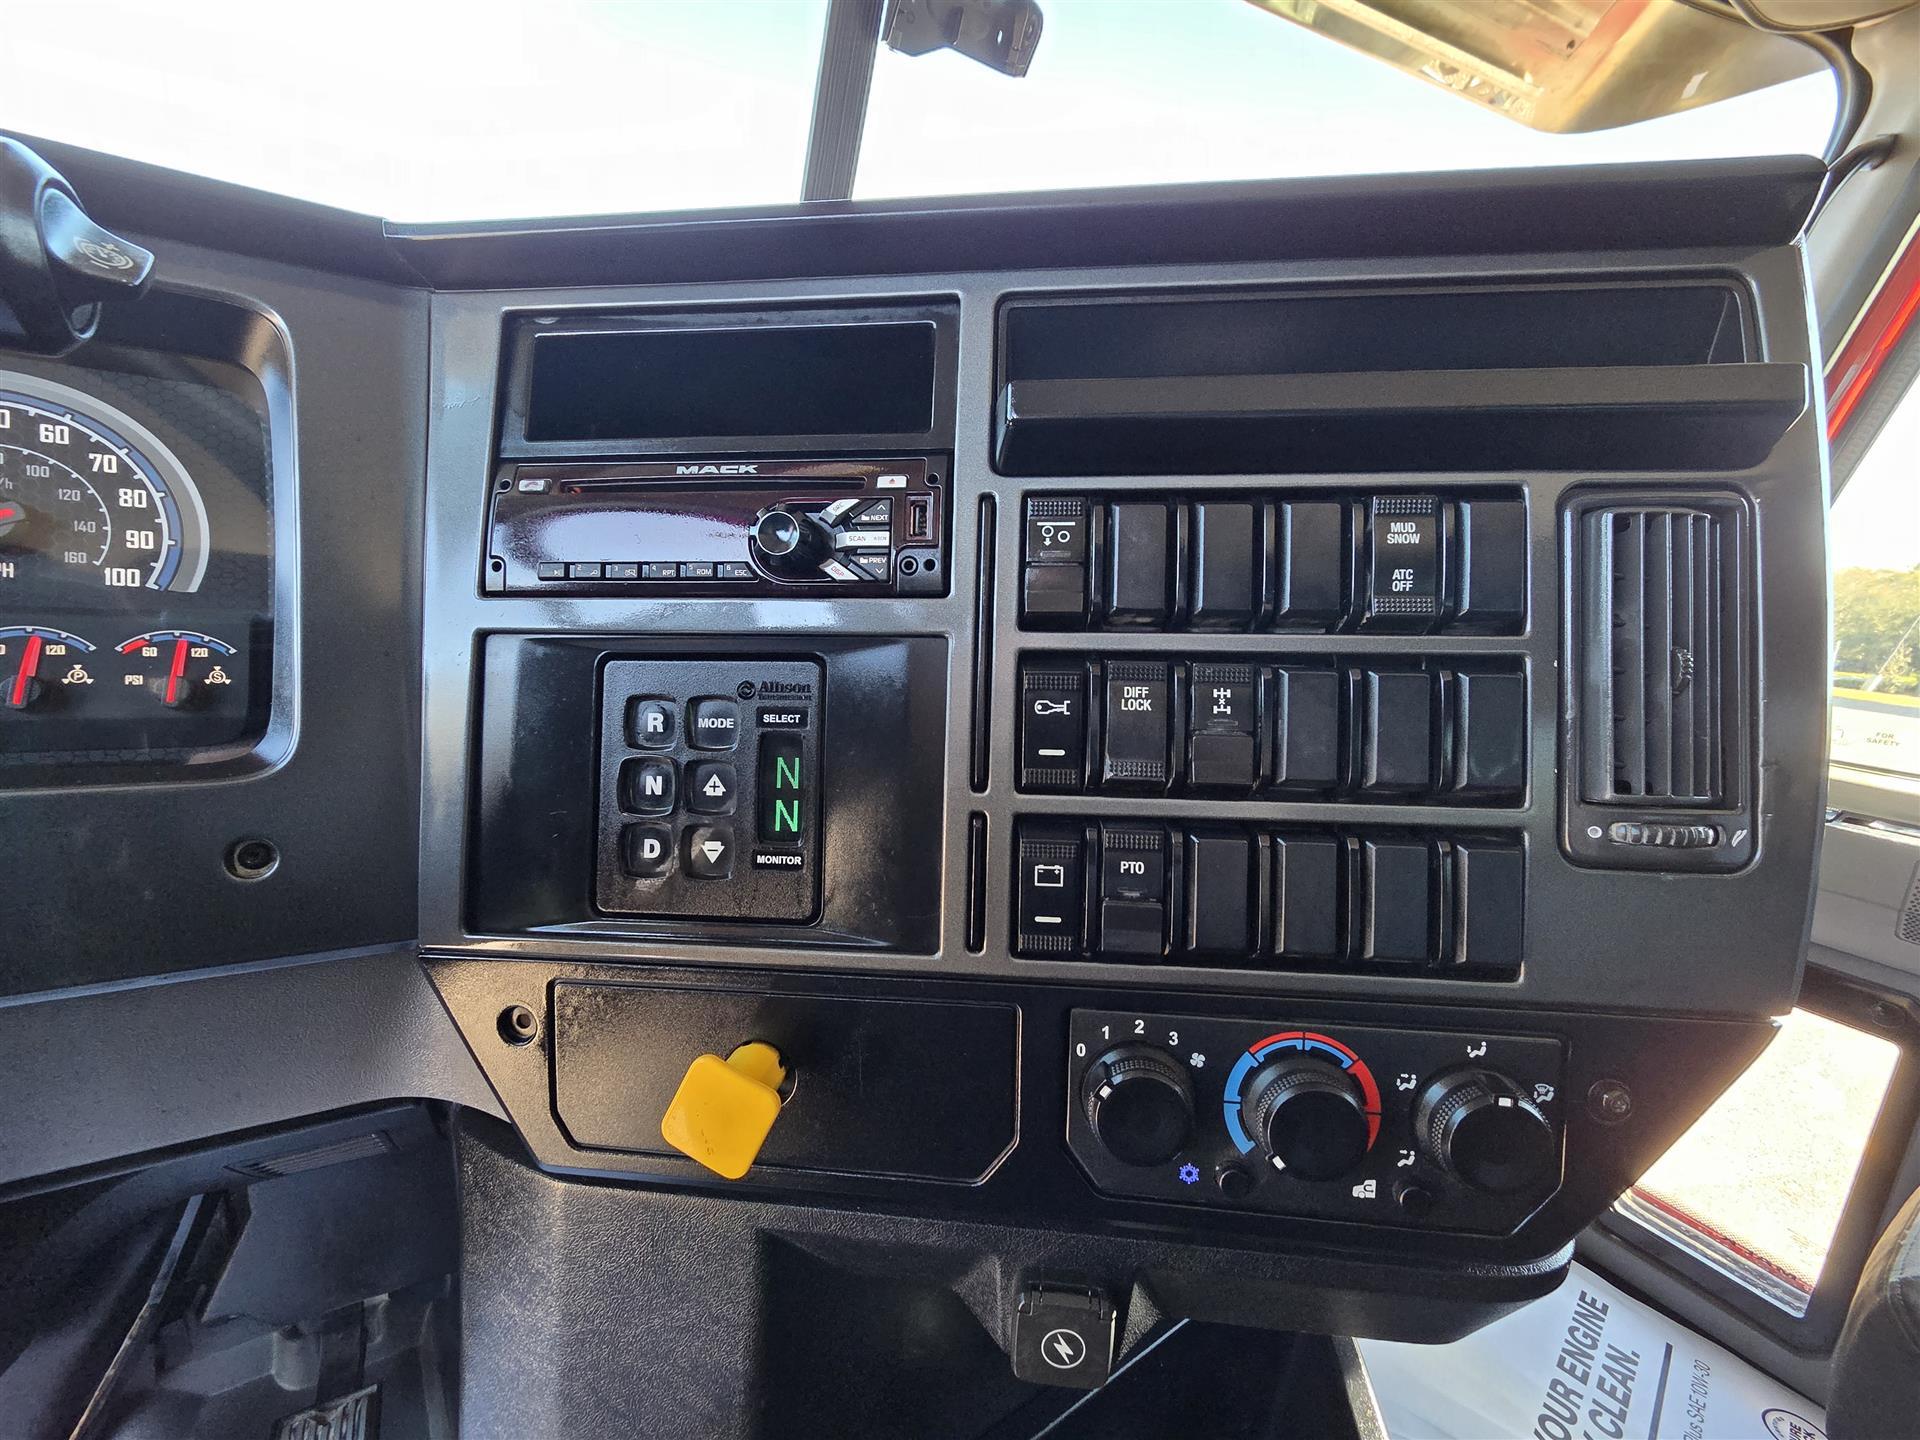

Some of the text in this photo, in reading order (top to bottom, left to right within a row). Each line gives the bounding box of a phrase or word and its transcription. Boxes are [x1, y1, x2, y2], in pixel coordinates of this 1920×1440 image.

[0, 409, 10, 429] 0
[39, 424, 69, 445] 60
[88, 453, 117, 473] 70
[676, 465, 758, 474] MACK
[26, 464, 50, 478] 100
[58, 488, 81, 502] 120
[118, 488, 147, 508] 80
[74, 520, 96, 533] 140
[1390, 522, 1416, 533] MUD
[125, 530, 154, 549] 90
[1387, 533, 1420, 544] SNOW
[64, 552, 87, 564] 160
[104, 567, 140, 587] 100
[1392, 569, 1413, 580] ATC
[1392, 581, 1413, 592] OFF
[45, 645, 66, 655] 120
[142, 647, 158, 657] 60
[190, 648, 208, 658] 120
[125, 675, 143, 685] PSI
[759, 681, 811, 693] Allison
[1124, 686, 1149, 698] DIFF
[1121, 699, 1152, 711] LOCK
[647, 713, 664, 732] R
[698, 718, 734, 728] MODE
[763, 714, 800, 723] SELECT
[777, 757, 800, 789] N
[645, 775, 663, 795] N
[775, 800, 799, 832] N
[643, 838, 660, 858] D
[757, 855, 801, 865] MONITOR
[1120, 861, 1145, 874] PTO
[1102, 1025, 1109, 1039] 1
[1134, 1020, 1144, 1034] 2
[1169, 1031, 1178, 1045] 3
[1076, 1043, 1086, 1057] 0
[1556, 1290, 1609, 1386] ENGINE
[1690, 1359, 1711, 1399] 10W-30
[1588, 1343, 1640, 1440] CLEAN.
[1686, 1394, 1706, 1423] SAE
